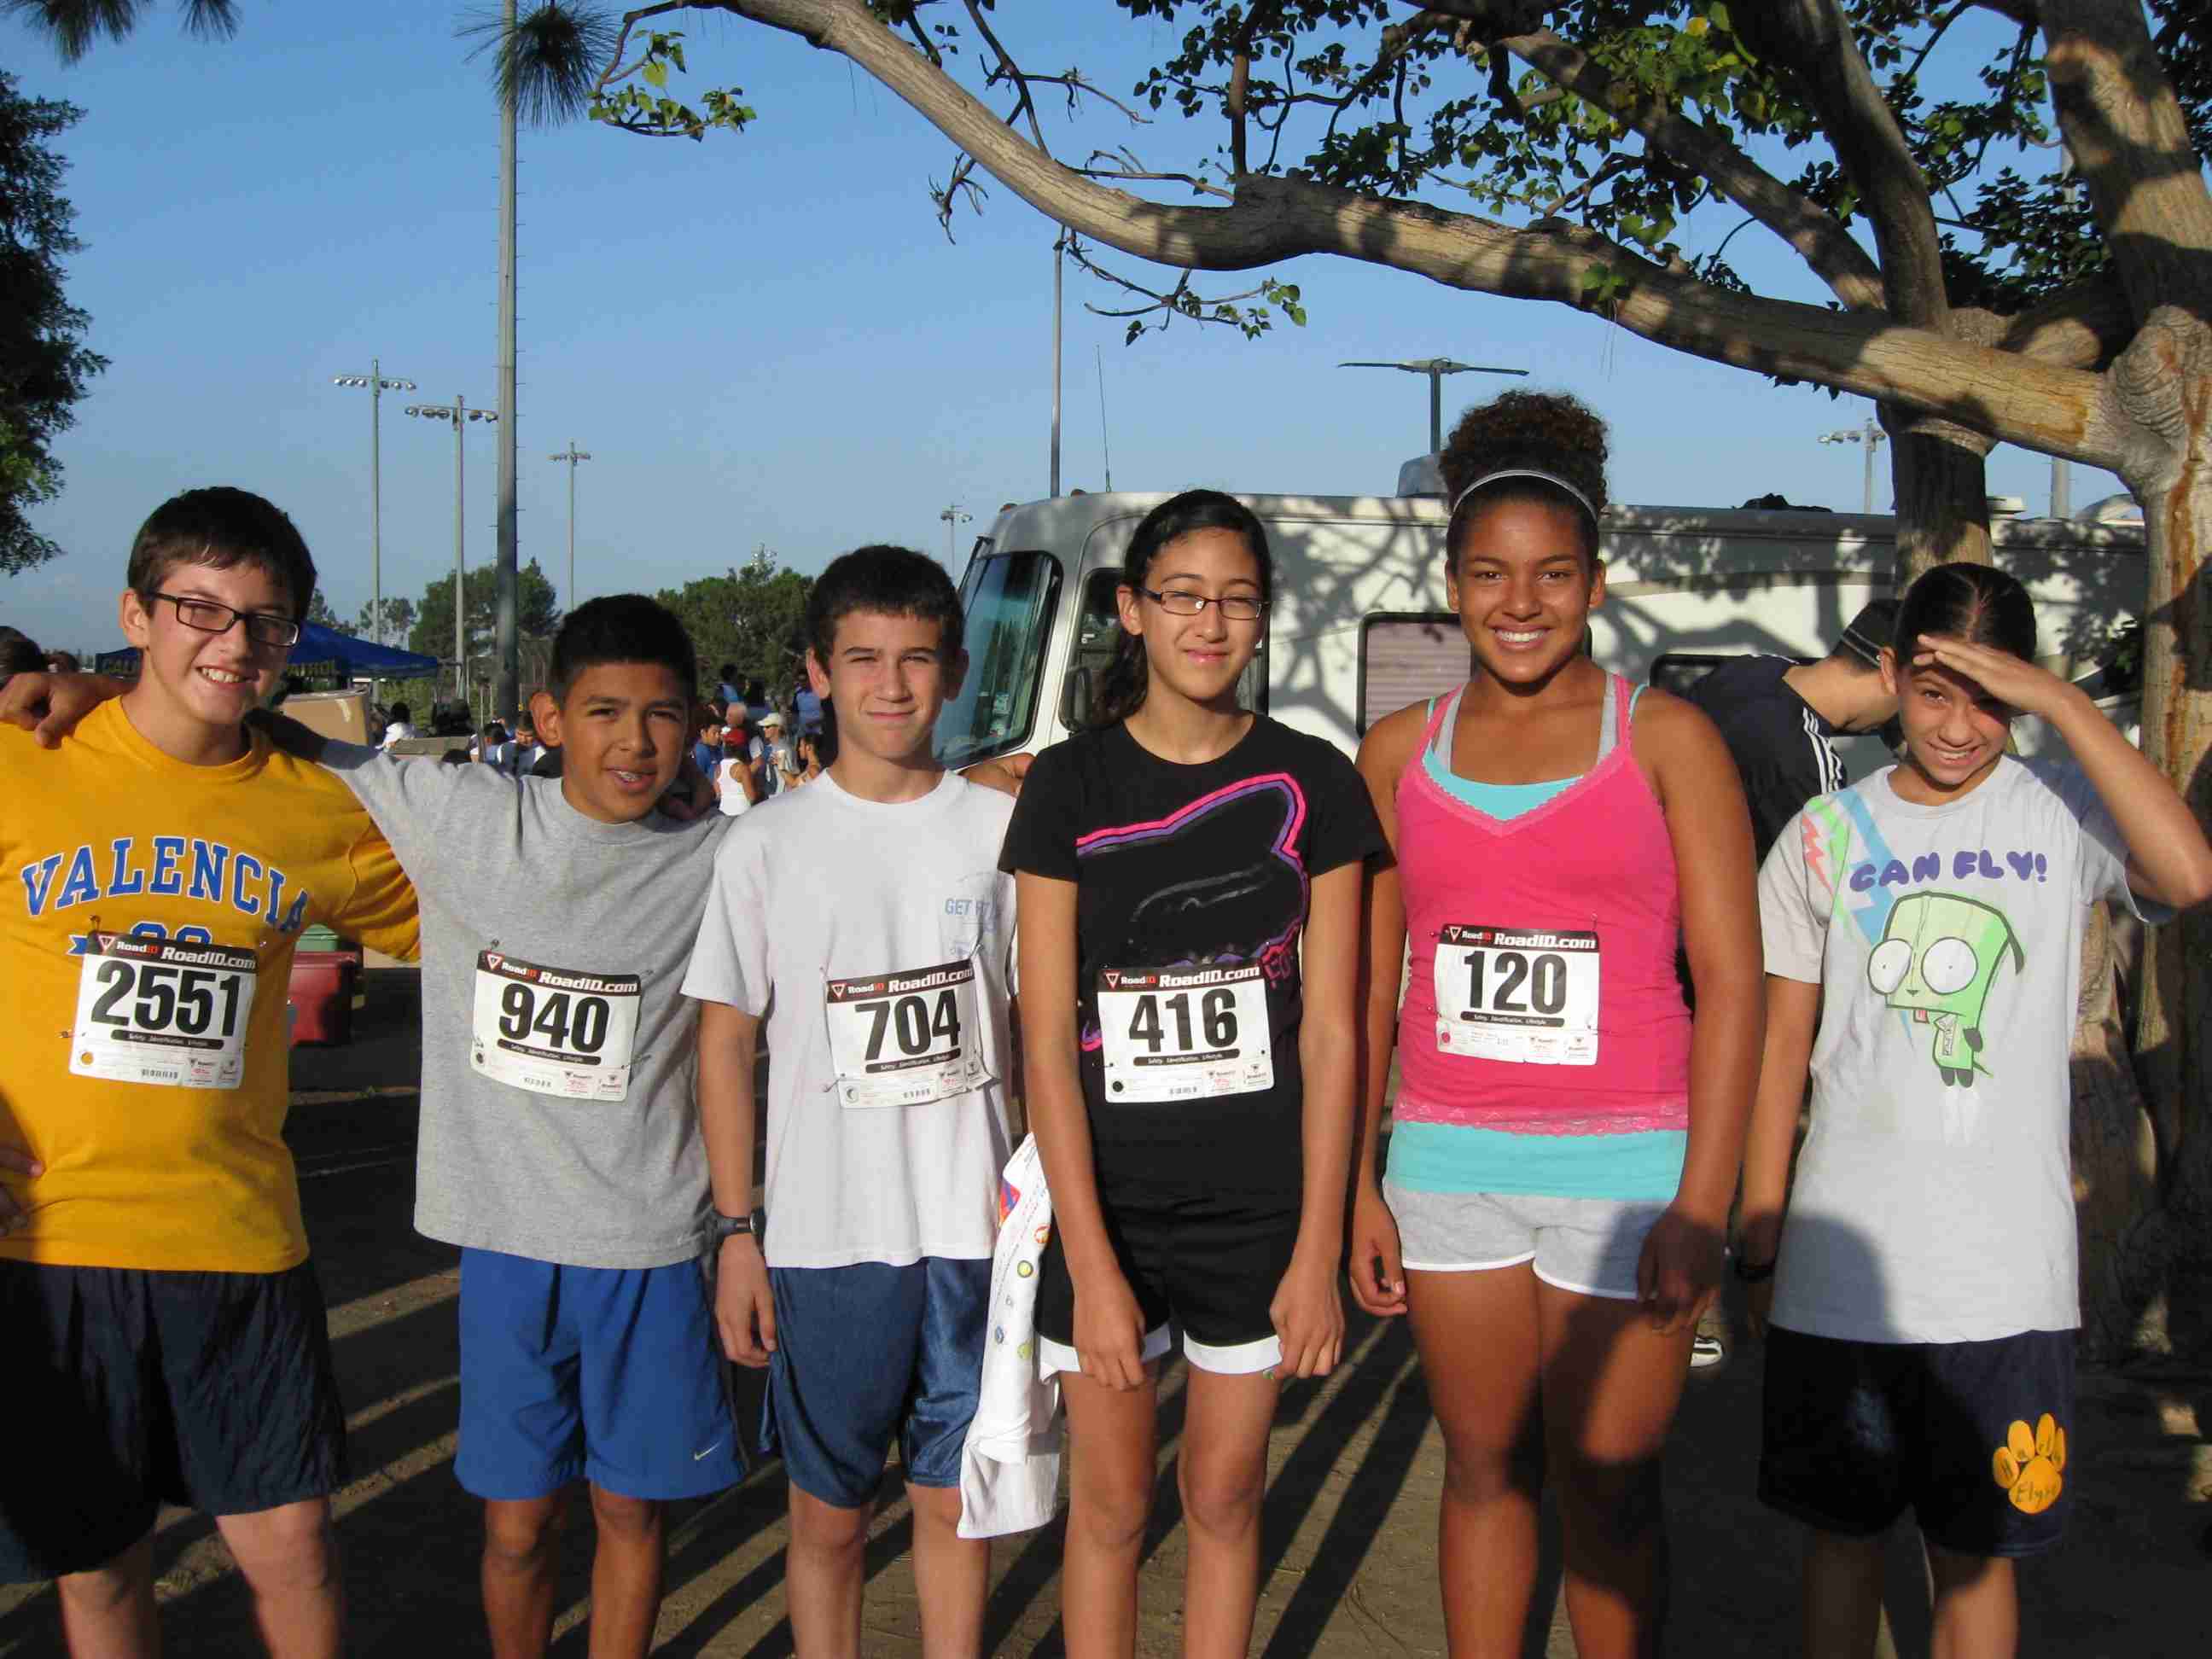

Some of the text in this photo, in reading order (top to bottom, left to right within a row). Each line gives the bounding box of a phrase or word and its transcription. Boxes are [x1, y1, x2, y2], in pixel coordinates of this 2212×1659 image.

[20, 835, 308, 934] VALENCIA
[1849, 850, 2047, 893] CAN FLY!
[160, 946, 256, 969] RoadID.com
[1494, 933, 1596, 950] RoadID.com
[90, 959, 240, 1037] 2551
[538, 971, 637, 992] RoadID.com
[1159, 966, 1260, 987] RoadID.com
[1464, 950, 1567, 1015] 120
[498, 983, 609, 1053] 940
[854, 988, 961, 1061] 704
[1128, 988, 1238, 1052] 416
